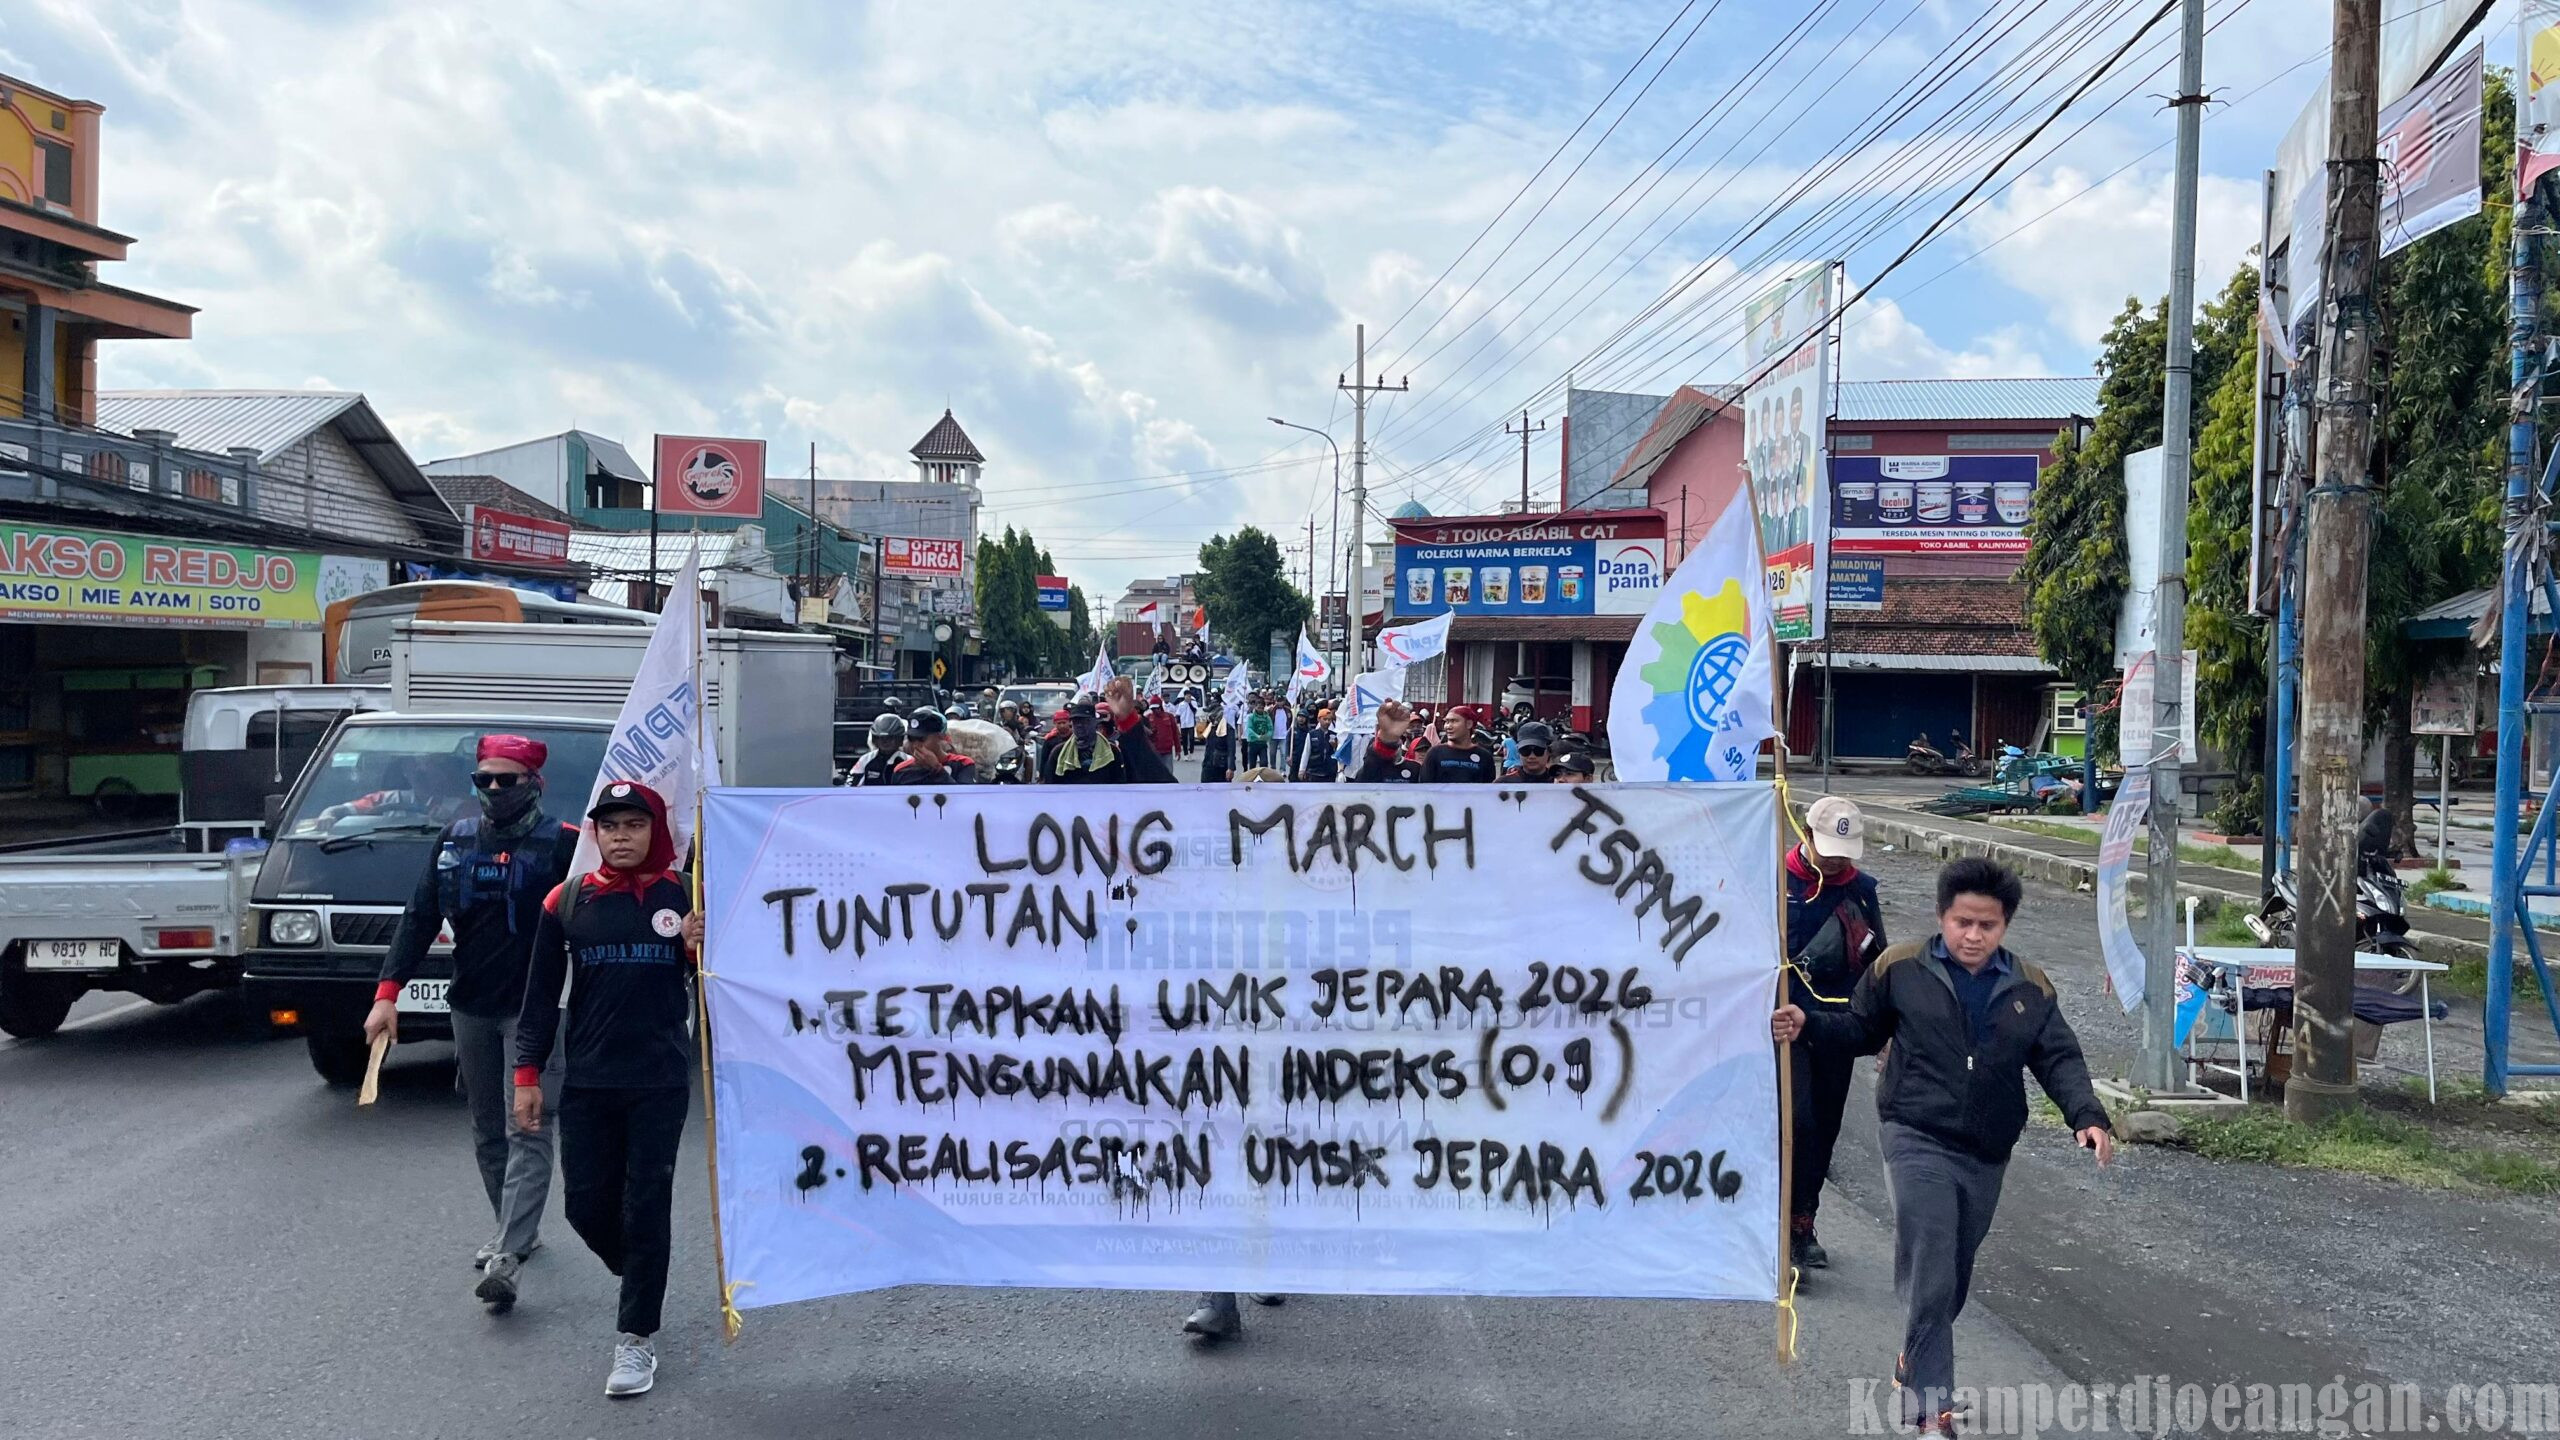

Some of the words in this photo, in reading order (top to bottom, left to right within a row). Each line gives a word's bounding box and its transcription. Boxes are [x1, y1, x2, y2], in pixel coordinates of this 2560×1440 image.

[1452, 529, 1501, 543] TOKO
[1580, 525, 1618, 540] CAT
[911, 540, 958, 553] OPTIK
[1416, 548, 1464, 560] KOLEKSI
[1465, 548, 1510, 559] WARNA
[1512, 546, 1572, 558] BERKELAS
[143, 545, 295, 592] REDJO
[911, 550, 959, 569] DIRGA
[1598, 559, 1649, 576] Dana
[1608, 574, 1659, 592] paint
[82, 588, 121, 605] MIE
[129, 590, 190, 609] AYAM
[209, 596, 261, 611] SOTO
[7, 610, 63, 620] MENERIMA
[31, 942, 39, 958] K
[52, 942, 87, 958] 9819
[99, 941, 117, 957] HC
[1158, 972, 1289, 1034] UMK
[1310, 966, 1504, 1030] JEPARA
[1518, 961, 1653, 1015] 2026
[847, 1042, 1250, 1112] MENGUNAKAN
[1282, 1046, 1468, 1104] INDEKS
[1413, 1137, 1606, 1207] JEPARA
[1629, 1149, 1743, 1202] 2026
